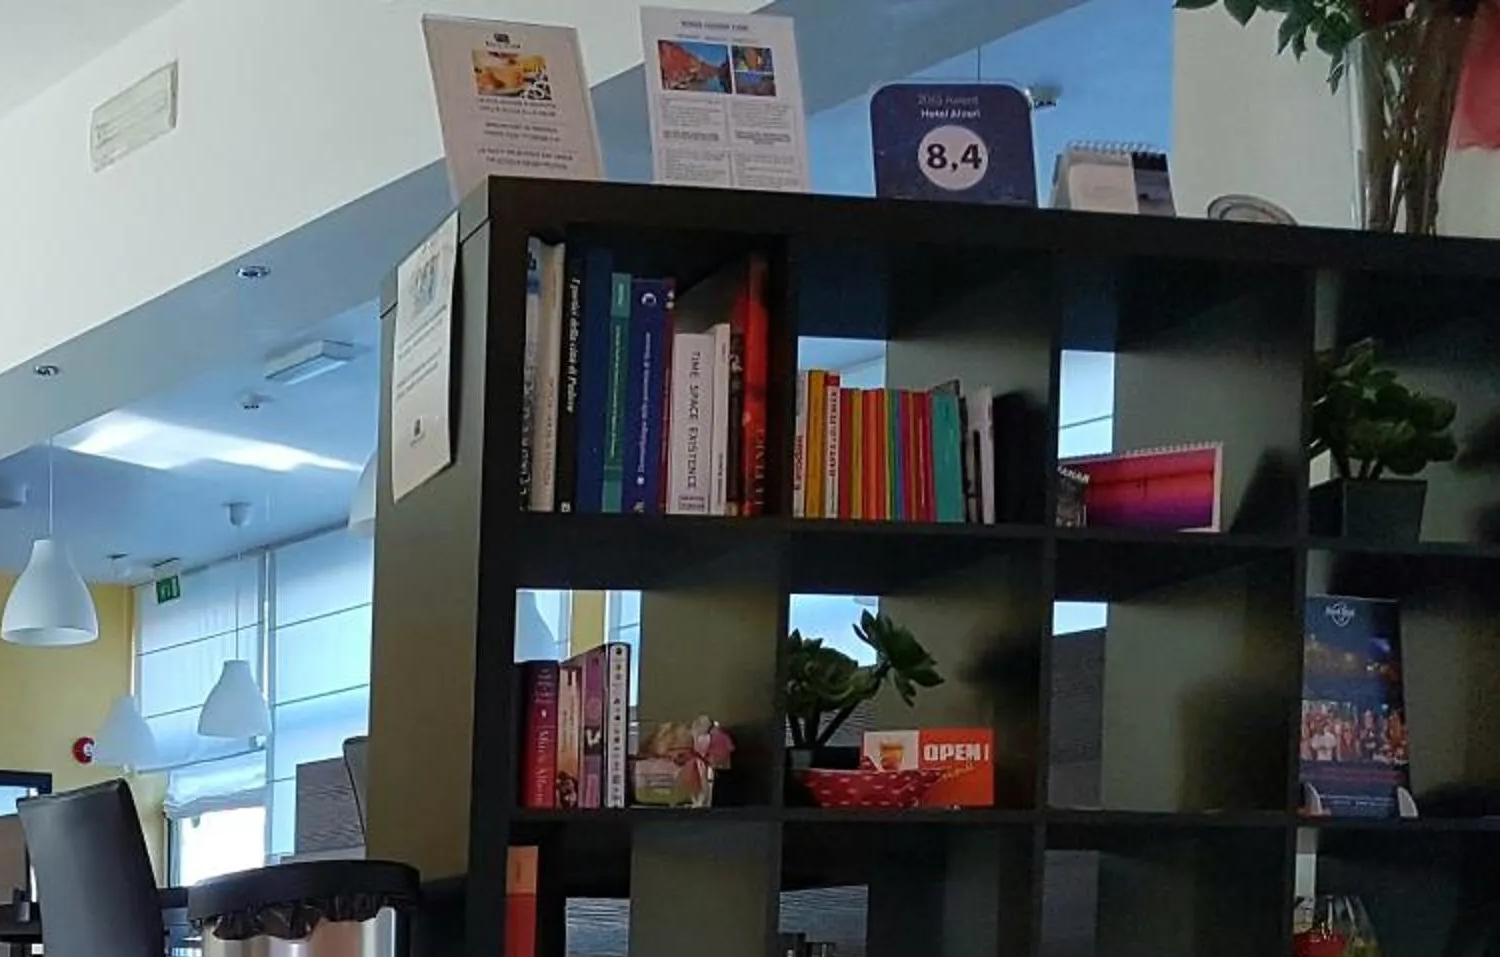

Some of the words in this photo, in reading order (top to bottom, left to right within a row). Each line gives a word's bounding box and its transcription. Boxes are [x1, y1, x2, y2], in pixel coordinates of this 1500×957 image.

[921, 107, 949, 119] Hotel
[927, 143, 983, 173] 8,4
[689, 351, 701, 379] TIME
[688, 385, 700, 420] SPACE
[687, 427, 699, 489] EXISTENCE
